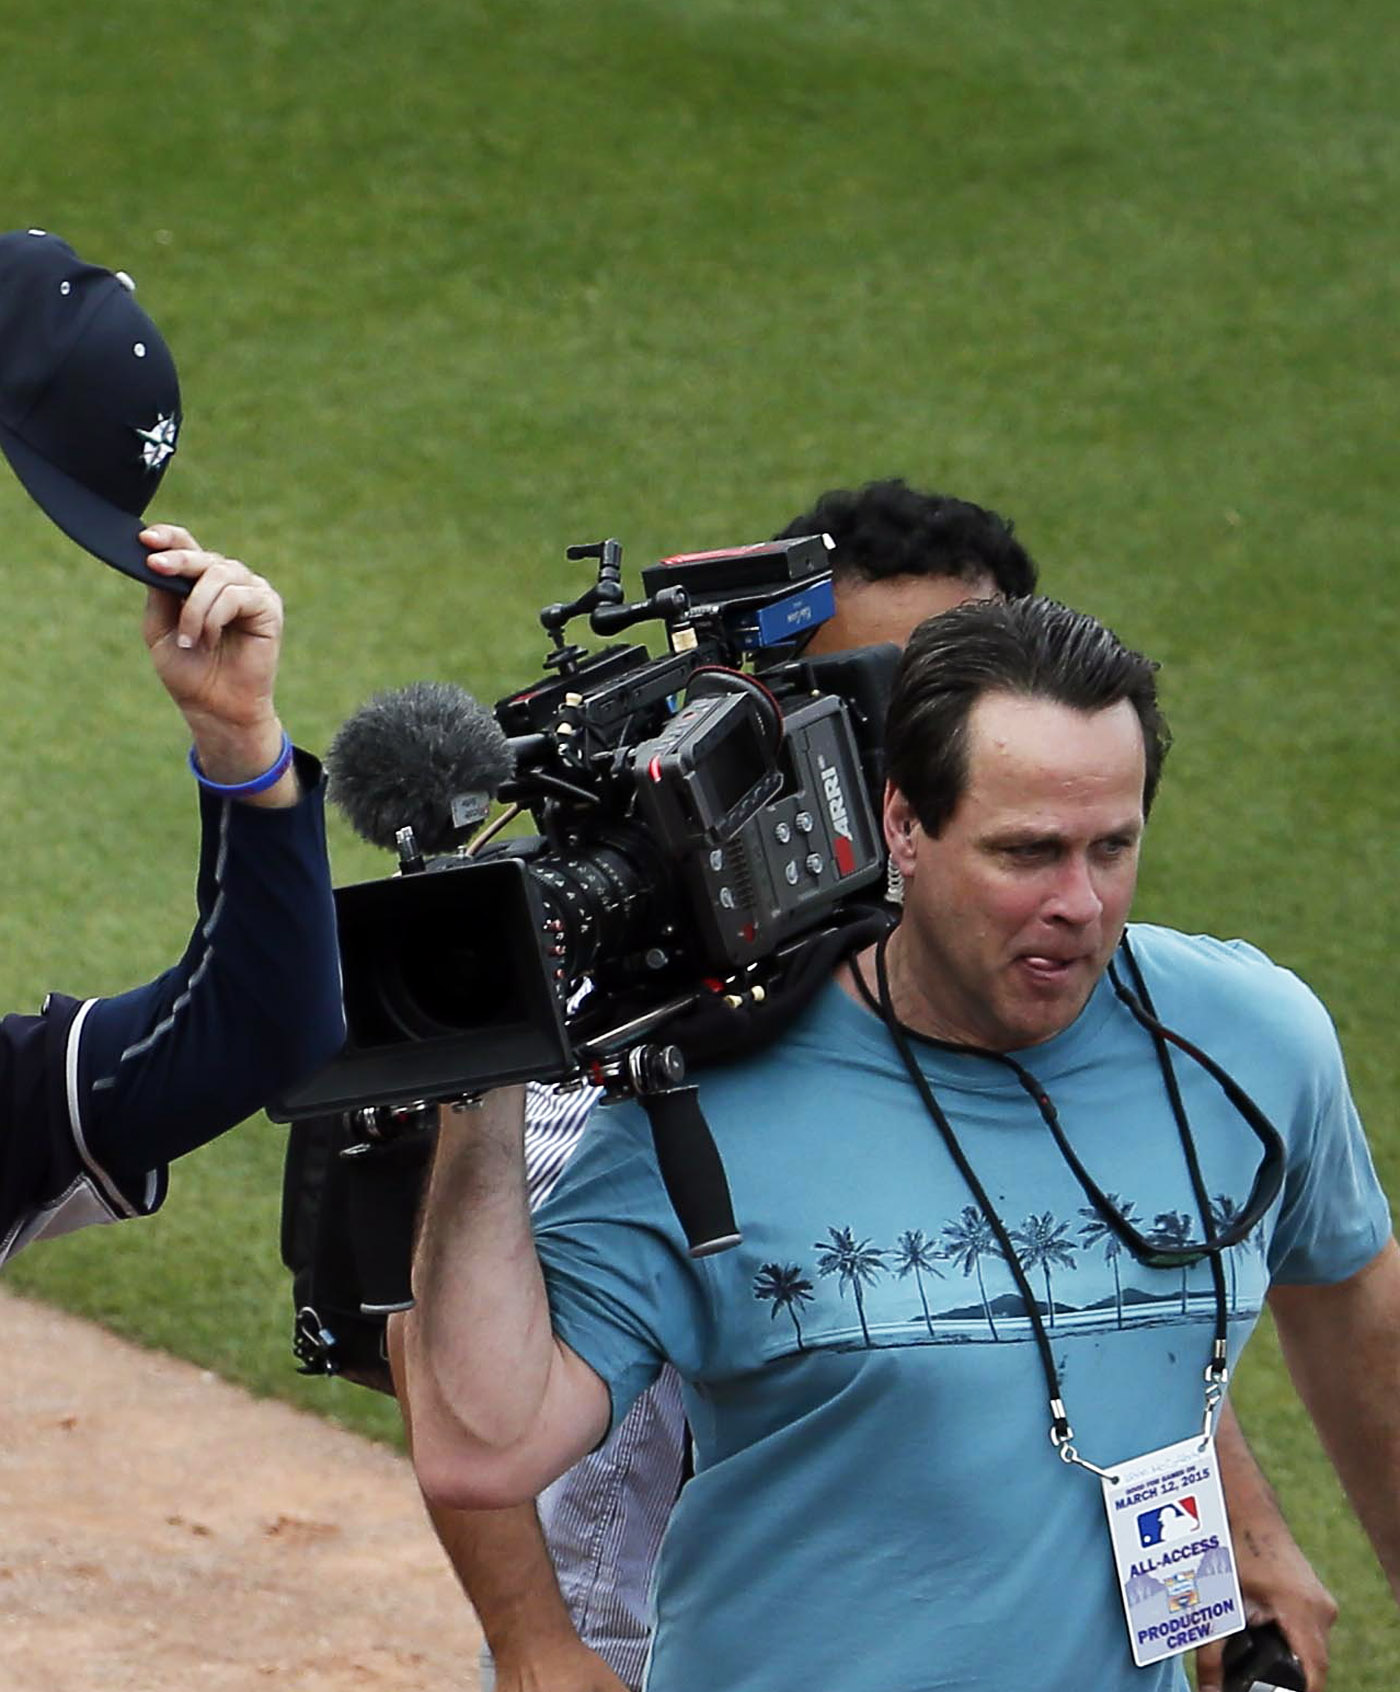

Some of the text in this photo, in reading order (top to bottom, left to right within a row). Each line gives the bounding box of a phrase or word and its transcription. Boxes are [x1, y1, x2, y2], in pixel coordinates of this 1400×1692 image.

[821, 766, 854, 841] ARRI
[1115, 1467, 1211, 1510] MARCH 12, 2015
[1130, 1535, 1219, 1578] ALL-ACCESS
[1138, 1598, 1234, 1644] PRODUCTION
[1167, 1622, 1211, 1649] CREW
